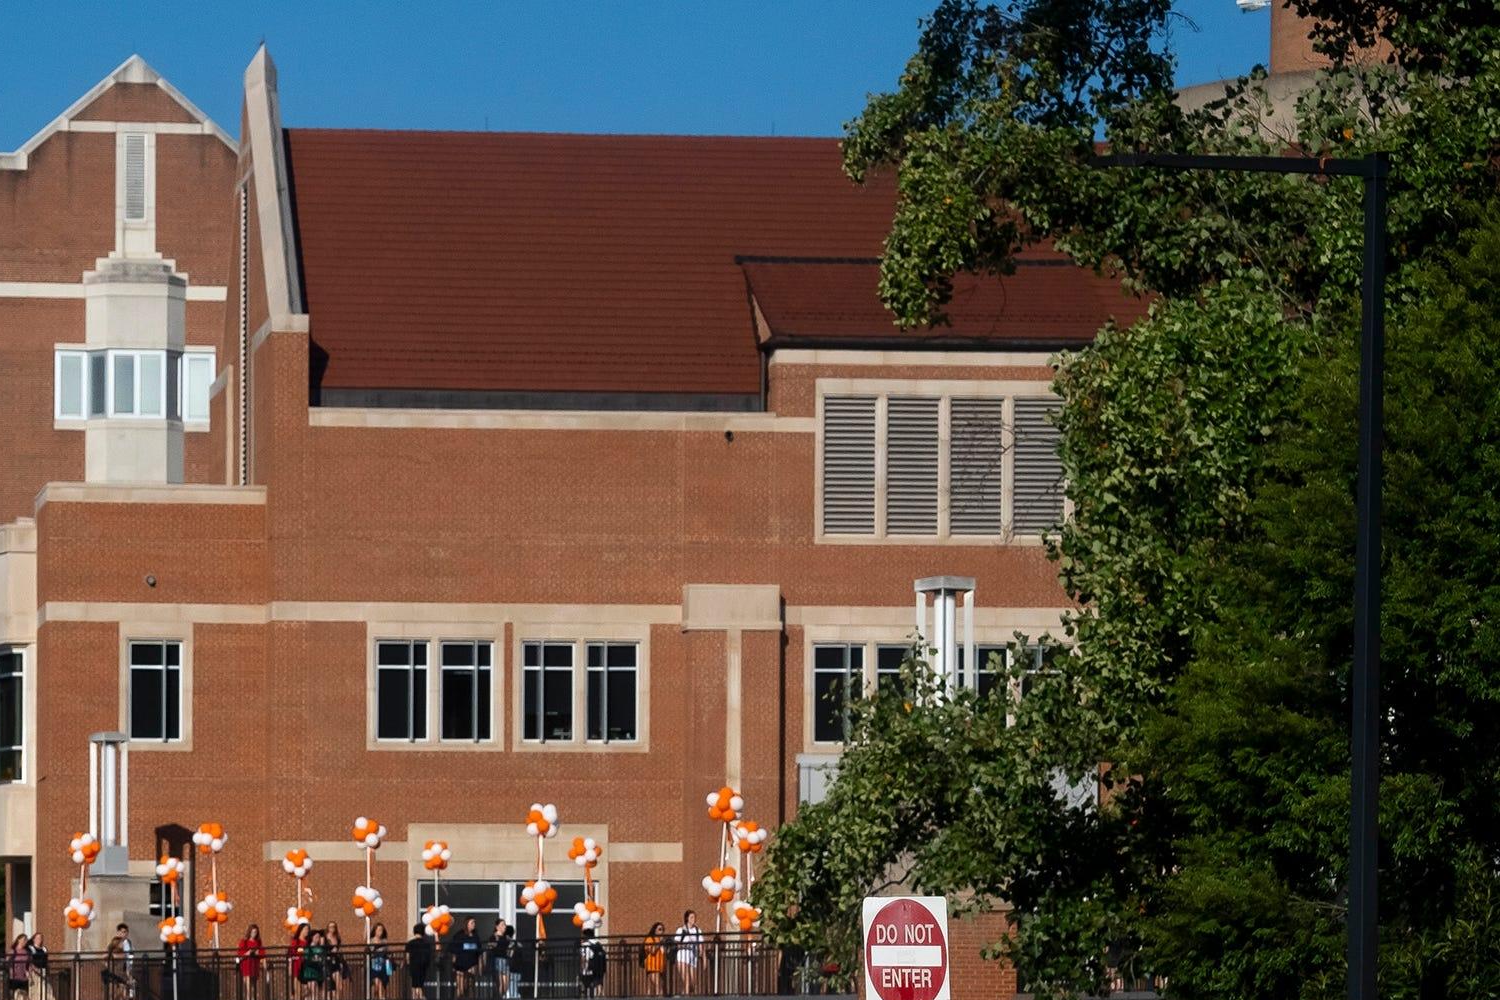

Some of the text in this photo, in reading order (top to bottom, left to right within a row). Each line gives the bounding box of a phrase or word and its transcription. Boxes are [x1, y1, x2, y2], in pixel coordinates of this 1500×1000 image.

[876, 923, 934, 944] DO NOT
[882, 968, 932, 989] ENTER
